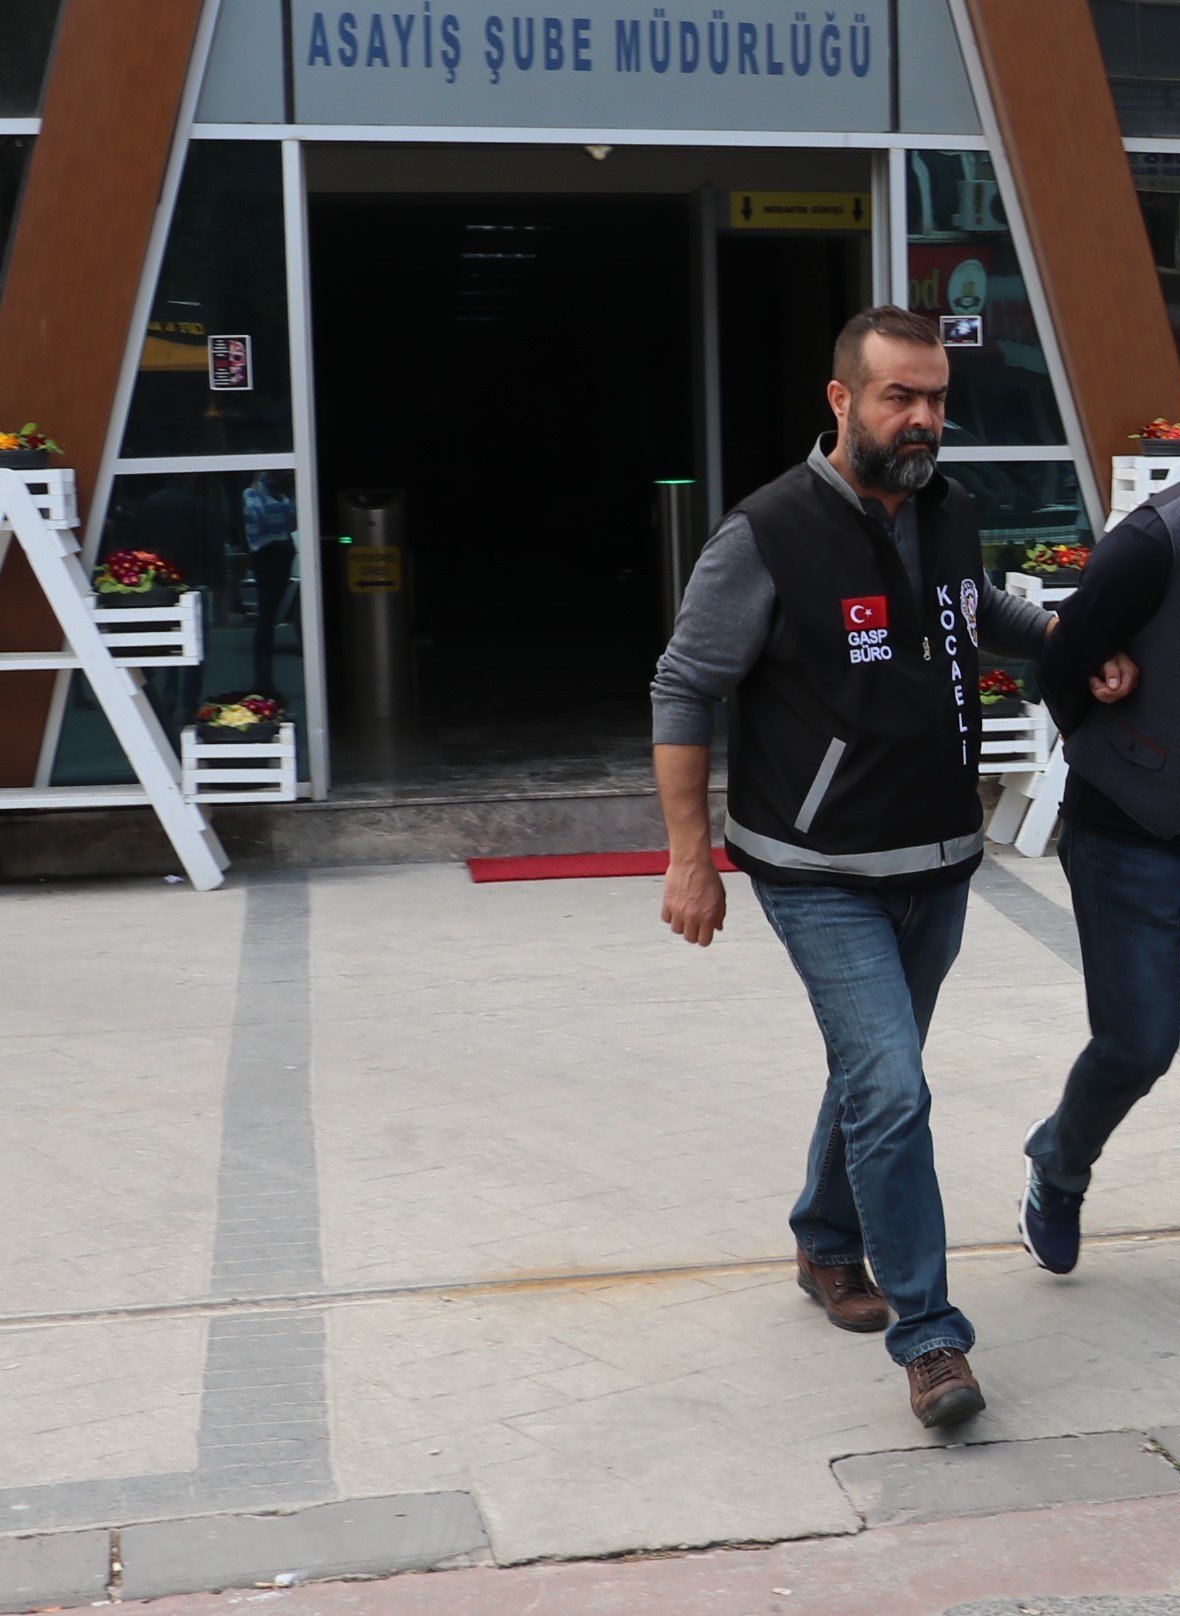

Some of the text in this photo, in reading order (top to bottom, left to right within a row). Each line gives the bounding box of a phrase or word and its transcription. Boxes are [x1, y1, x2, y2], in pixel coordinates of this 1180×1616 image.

[307, 1, 872, 85] ASAYİŞ ŞUBE MÜDÜRLÜĞÜ
[848, 629, 888, 646] GASP
[850, 645, 892, 663] BÜRO
[936, 584, 968, 765] KOCAELİ
